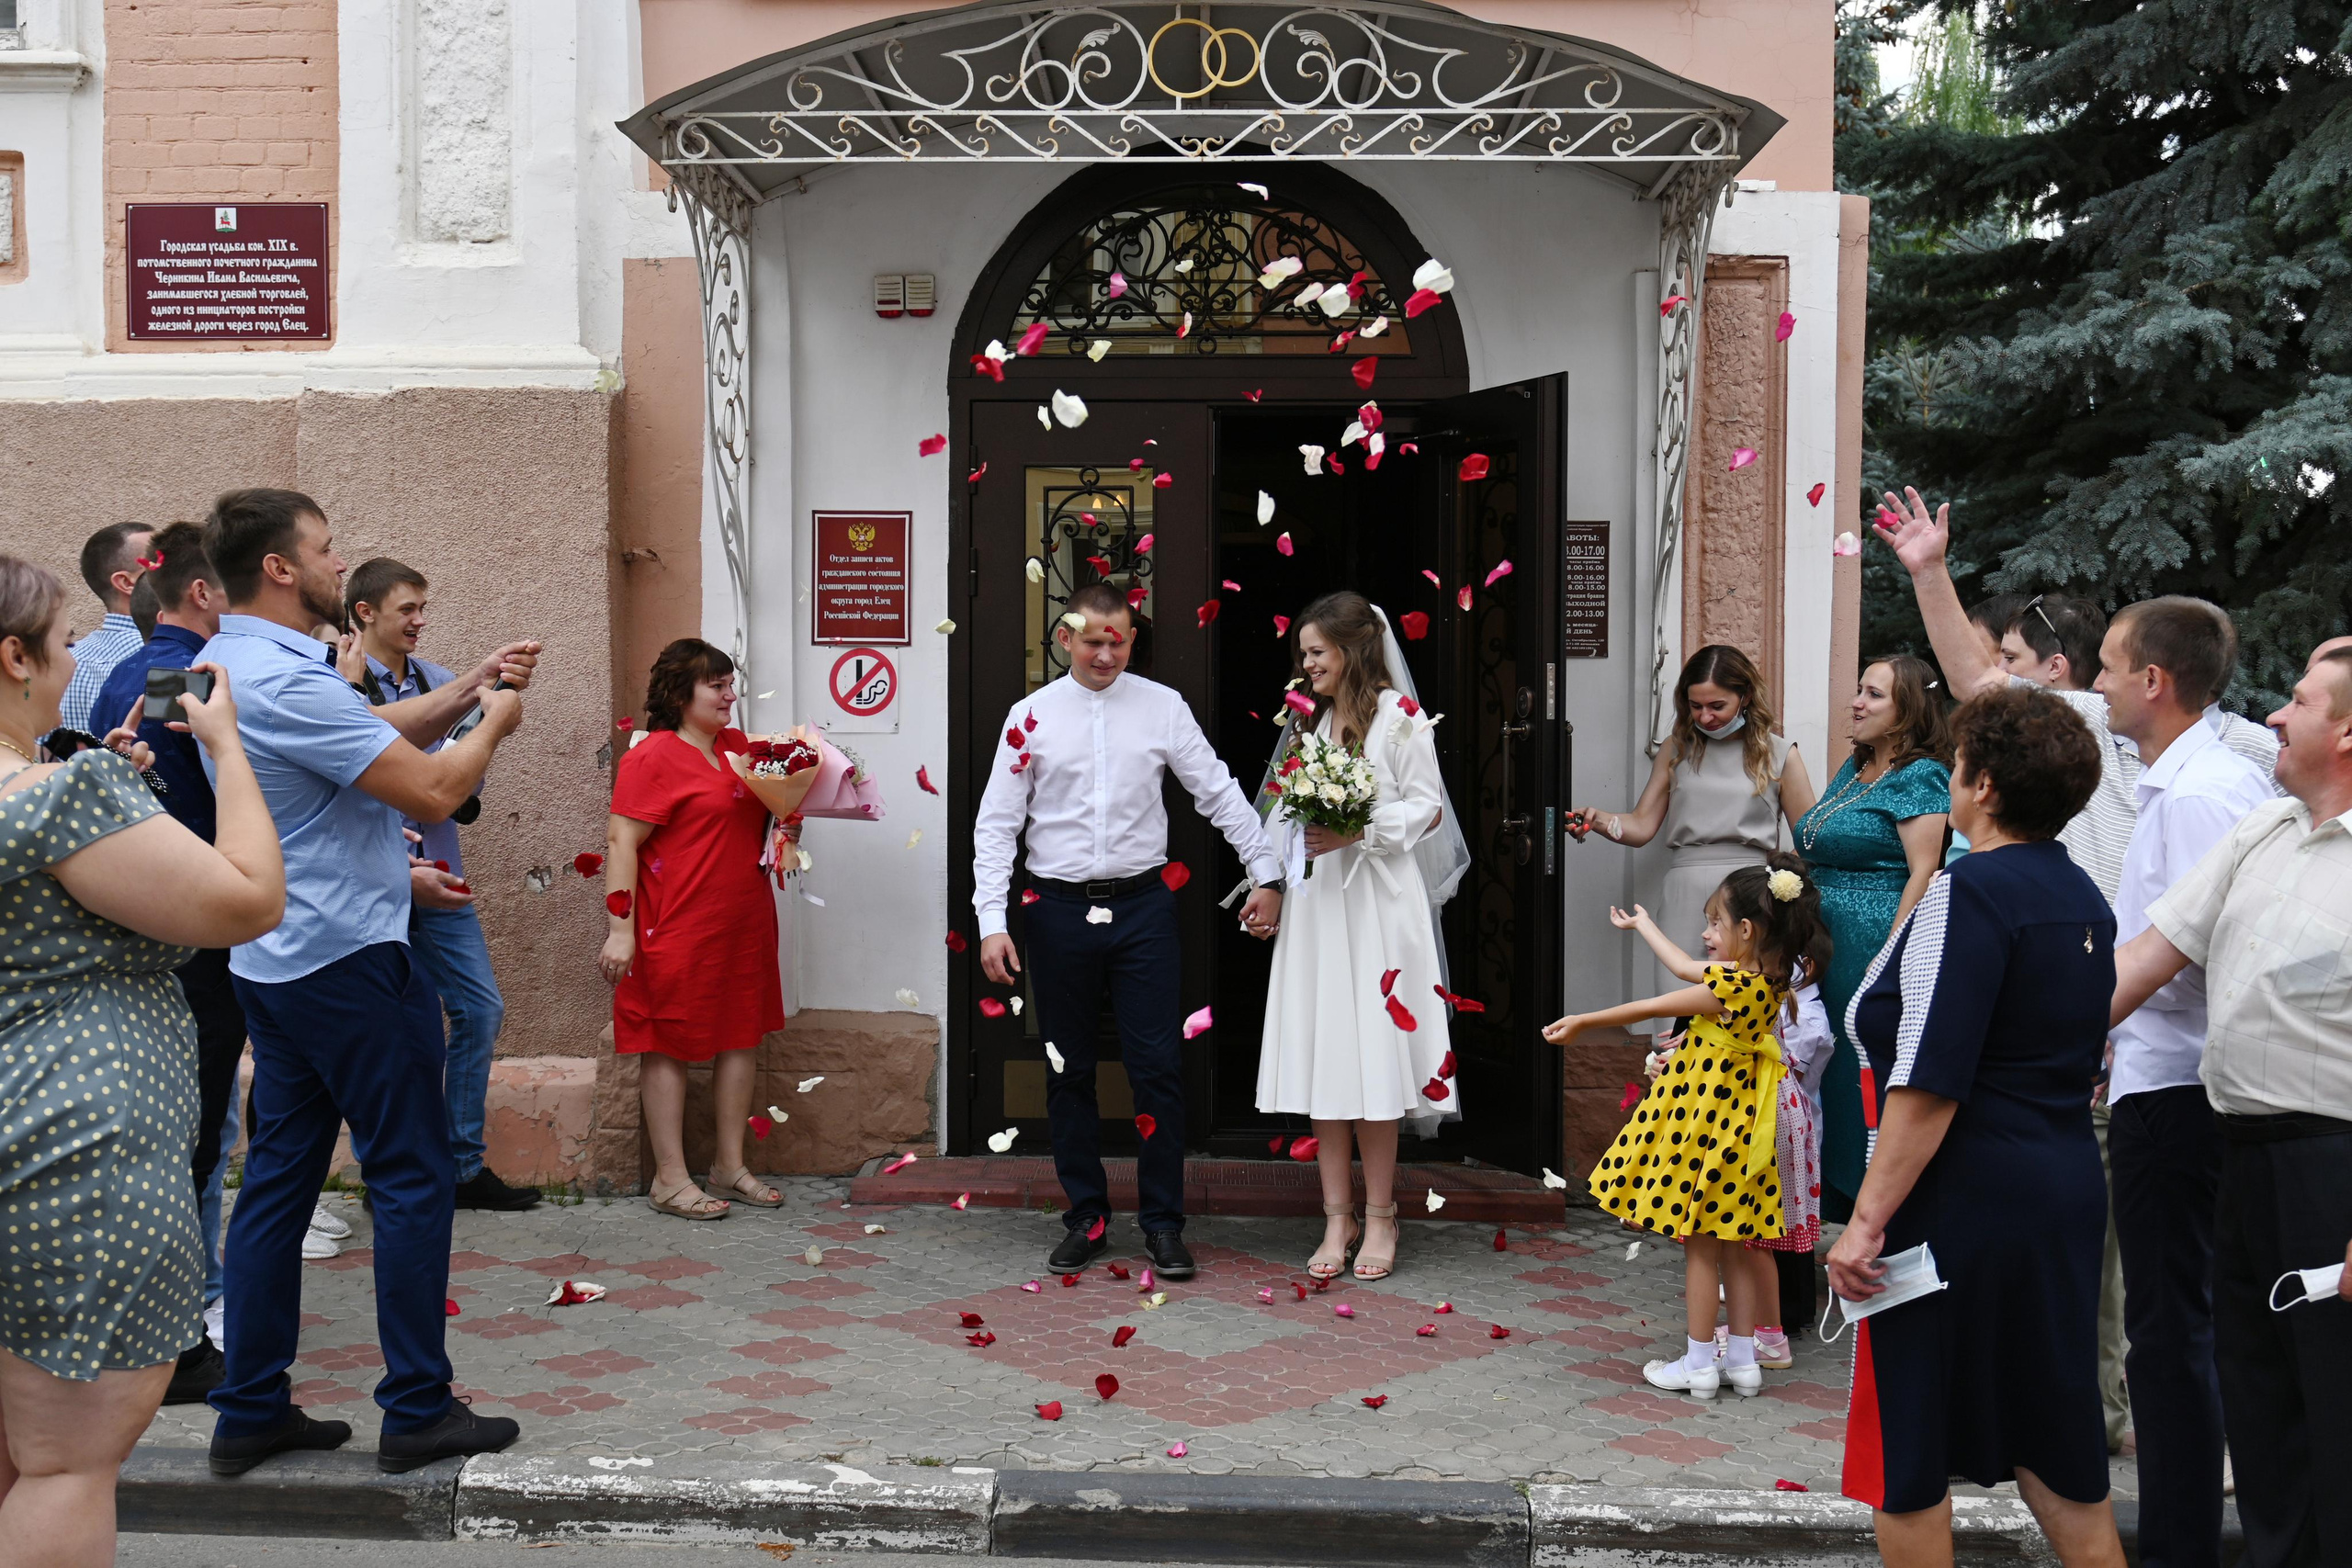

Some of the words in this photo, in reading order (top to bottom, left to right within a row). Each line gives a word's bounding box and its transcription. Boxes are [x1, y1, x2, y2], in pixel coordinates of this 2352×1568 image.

[161, 240, 206, 254] Городская
[209, 243, 245, 254] усадьба
[248, 243, 266, 251] кон.
[138, 259, 211, 267] потомственного
[263, 259, 317, 270] гражданина
[155, 272, 204, 286] Черникина
[208, 271, 236, 282] Ивана
[239, 271, 300, 284] Васильевича,
[147, 290, 218, 299] занимавшегося
[220, 288, 256, 301] хлебной
[259, 288, 308, 301] торговлей,
[152, 306, 181, 316] одного
[198, 306, 255, 317] инициаторов
[259, 304, 304, 317] постройки
[149, 320, 191, 331] железной
[194, 321, 224, 333] дороги
[227, 321, 253, 333] через
[255, 321, 280, 333] город
